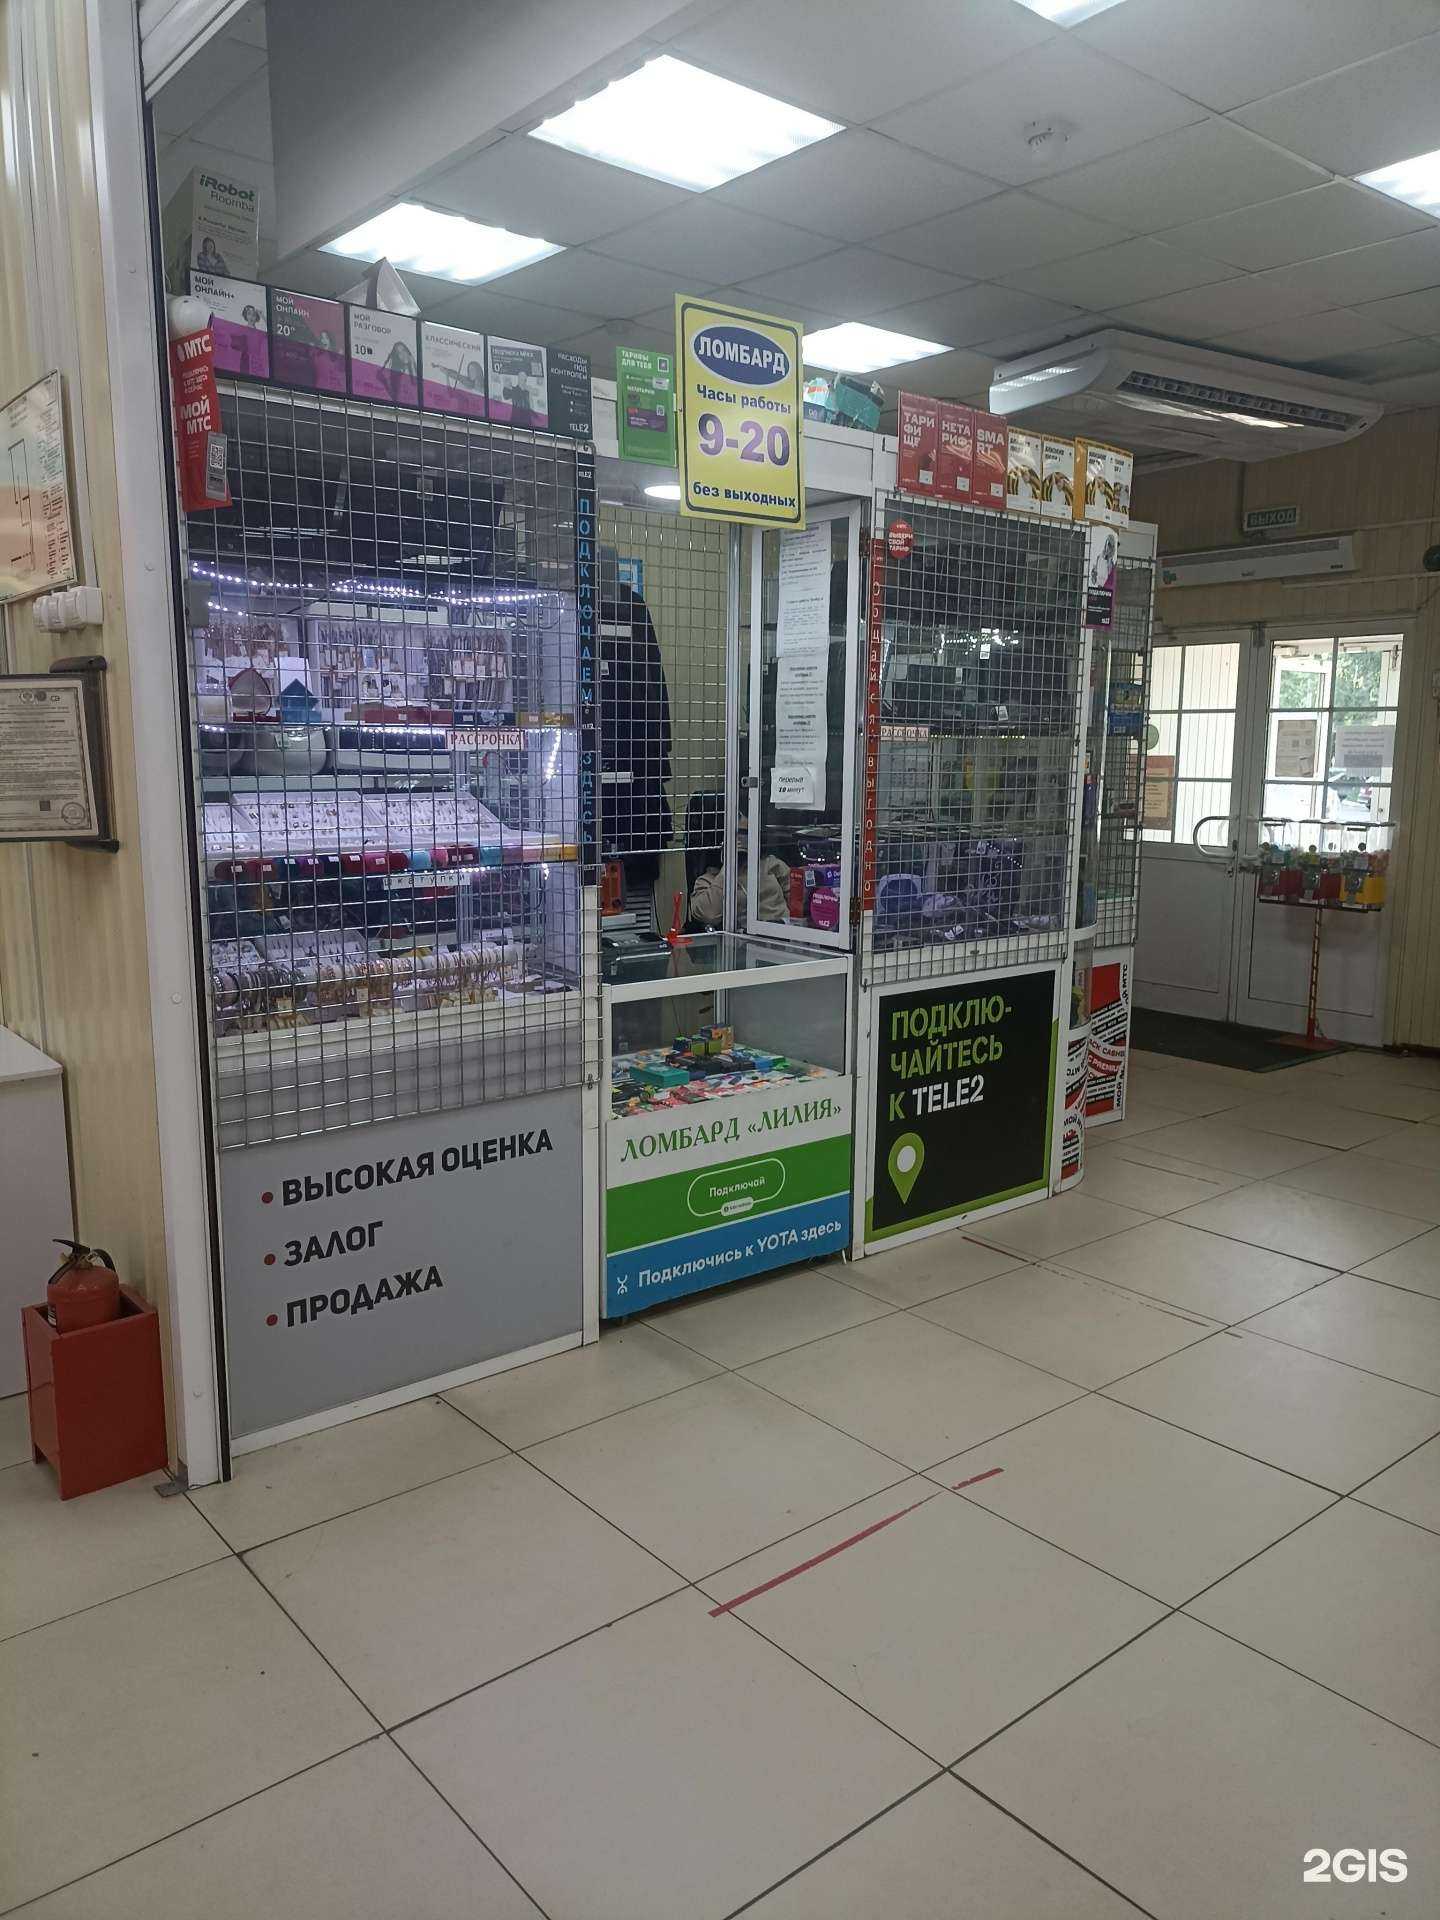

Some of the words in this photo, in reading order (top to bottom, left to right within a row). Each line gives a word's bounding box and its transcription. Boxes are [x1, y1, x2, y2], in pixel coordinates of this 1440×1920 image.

[200, 174, 255, 201] iRobot
[183, 334, 212, 360] МТС
[697, 336, 786, 376] ЛОМБАРД
[180, 395, 210, 420] МОЙ
[696, 384, 737, 404] Часы
[741, 395, 791, 414] работы
[186, 416, 212, 435] МТС
[569, 423, 589, 433] TELE2
[903, 412, 935, 428] ТАРИ
[903, 424, 922, 437] ФИ
[942, 420, 971, 436] НЕТА
[698, 413, 791, 467] 9-20
[976, 429, 1005, 446] SMA
[693, 481, 720, 498] без
[724, 488, 797, 508] выходных
[1249, 510, 1296, 526] ВЫХОД
[449, 733, 521, 746] РАССРОЧКА
[891, 994, 1012, 1041] ПОДКЛЮ-
[890, 1034, 1004, 1080] ЧАЙТЕСЬ
[889, 1090, 906, 1122] К
[912, 1074, 985, 1116] TELE2
[620, 1116, 740, 1162] ЛОМБАРД
[747, 1098, 842, 1134] «ЛИЛИЯ»
[282, 1151, 435, 1206] ВЫСОКАЯ
[441, 1128, 553, 1171] ОЦЕНКА
[709, 1176, 766, 1198] Подключай
[283, 1219, 384, 1267] ЗАЛОГ
[638, 1247, 742, 1288] Подключись
[745, 1245, 754, 1257] к
[757, 1230, 799, 1252] YOTA
[801, 1220, 842, 1242] здесь
[286, 1265, 443, 1328] ПРОДАЖА
